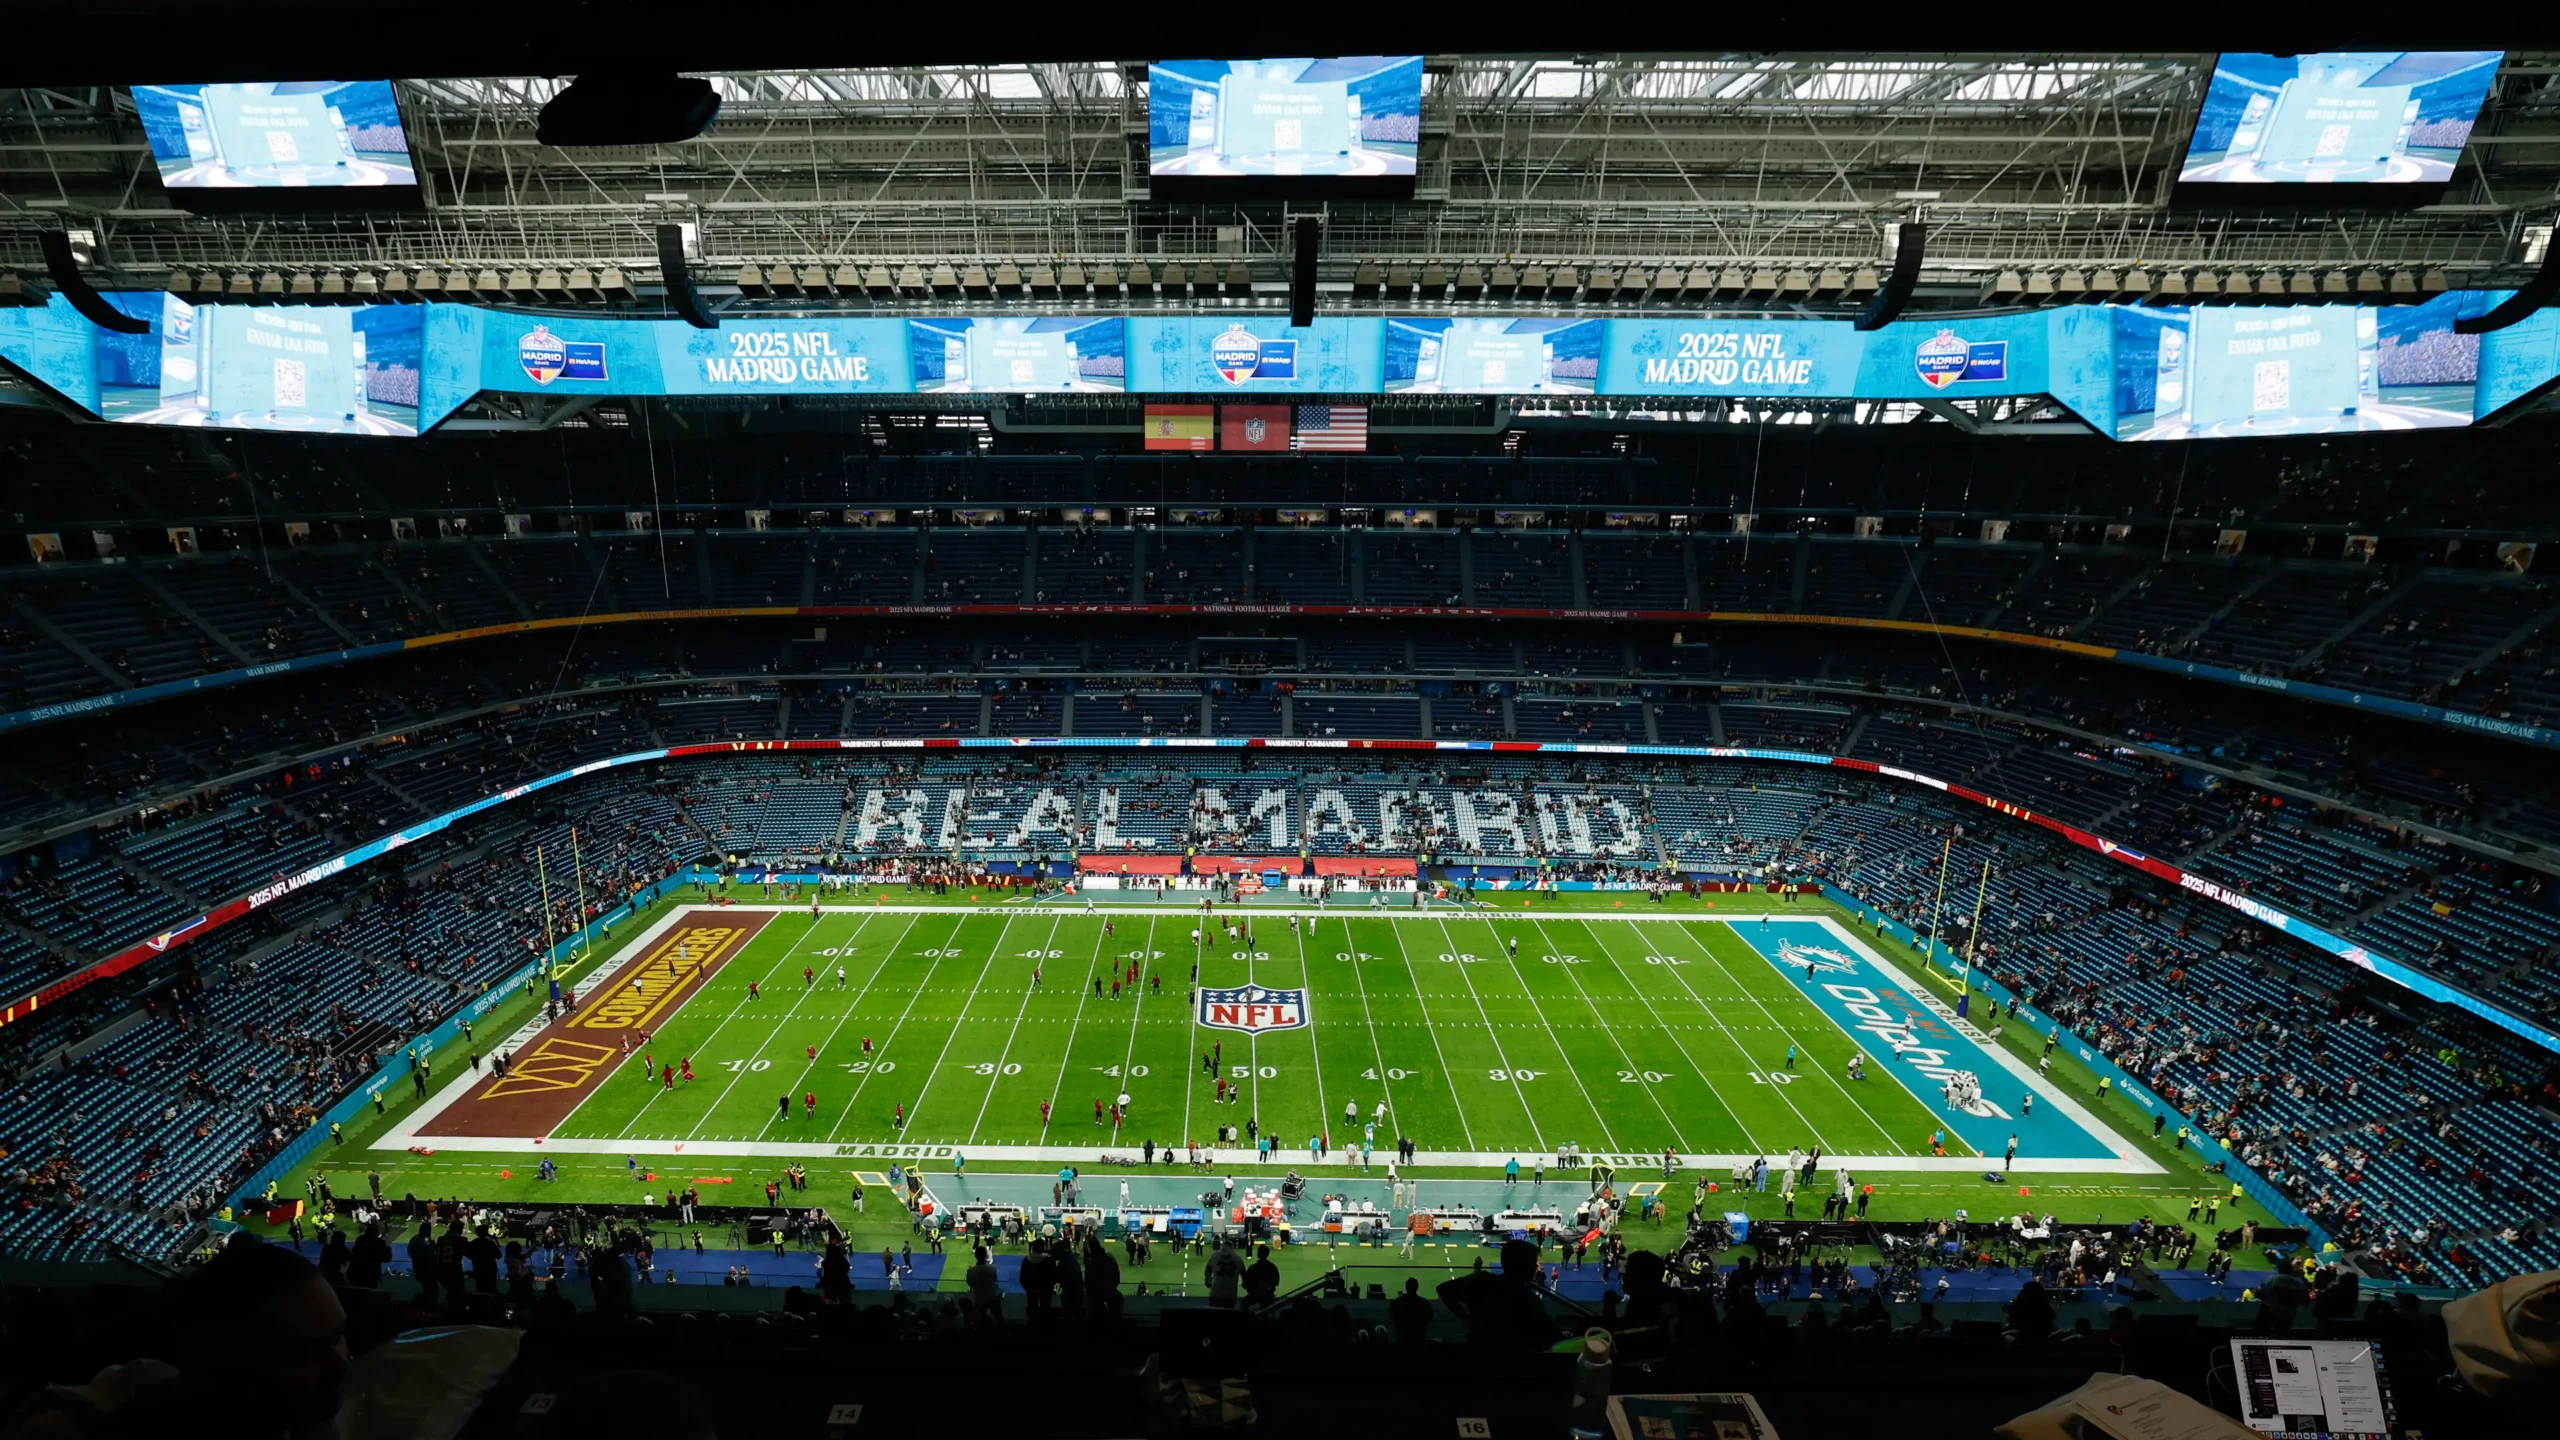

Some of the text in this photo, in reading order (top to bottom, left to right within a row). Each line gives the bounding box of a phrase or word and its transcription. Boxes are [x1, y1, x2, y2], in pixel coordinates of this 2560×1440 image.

[730, 332, 837, 357] 2025 NFL
[1677, 333, 1785, 358] 2025 NFL
[522, 352, 561, 361] MADRID
[576, 358, 600, 366] NetApp
[1215, 353, 1256, 361] MADRID
[1919, 356, 1964, 365] MADRID
[706, 357, 869, 383] MADRID GAME
[1645, 359, 1812, 385] MADRID GAME
[1248, 428, 1264, 439] NFL
[1203, 605, 1291, 613] NATIONAL FOOTBALL LEAGUE
[246, 662, 291, 677] MIAMI DOLPHINS
[2257, 677, 2288, 690] DOLPHINS
[30, 696, 115, 721] 2025 NFL MADRID GAME
[2462, 715, 2477, 727] NFL
[2478, 718, 2511, 734] MADRID
[2510, 725, 2538, 739] GAME
[881, 740, 924, 748] COMMANDERS
[1305, 740, 1349, 748] COMMANDERS
[1915, 774, 1948, 790] COMMANDERS
[853, 787, 1641, 855] REAL MADRID
[996, 852, 1009, 861] NFL
[1457, 857, 1472, 865] NFL
[1472, 857, 1504, 866] MADRID
[1504, 857, 1526, 866] GAME
[1701, 864, 1738, 873] DOLPHINS
[248, 856, 346, 910] 2025 NFL MADRID GAME
[857, 875, 885, 884] MADRID
[886, 875, 909, 883] GAME
[1612, 882, 1628, 890] NFL
[2180, 873, 2289, 929] 2025 NFL MADRID GAME
[590, 972, 606, 982] OF
[601, 959, 625, 970] US
[583, 927, 732, 1029] COMMANDERS
[473, 964, 537, 1016] 2025 NFL MADRID GAME
[1211, 1004, 1297, 1028] NFL
[1876, 988, 1955, 1041] MIAMI
[1908, 988, 1994, 1046] END RACISM
[421, 1045, 433, 1057] cisco
[2080, 1047, 2092, 1062] VISA
[726, 1059, 771, 1072] 10
[848, 1062, 896, 1074] 20
[974, 1063, 1022, 1076] 30
[1103, 1065, 1149, 1077] 40
[1231, 1066, 1277, 1078] 50
[1360, 1068, 1406, 1080] 40
[1490, 1069, 1536, 1081] 30
[1617, 1071, 1664, 1084] 20
[1747, 1072, 1792, 1084] 10
[371, 1075, 388, 1091] NetApp
[2127, 1084, 2154, 1108] Santander
[835, 1144, 953, 1159] MADRID
[836, 1408, 857, 1420] 14
[1462, 1422, 1486, 1434] 16
